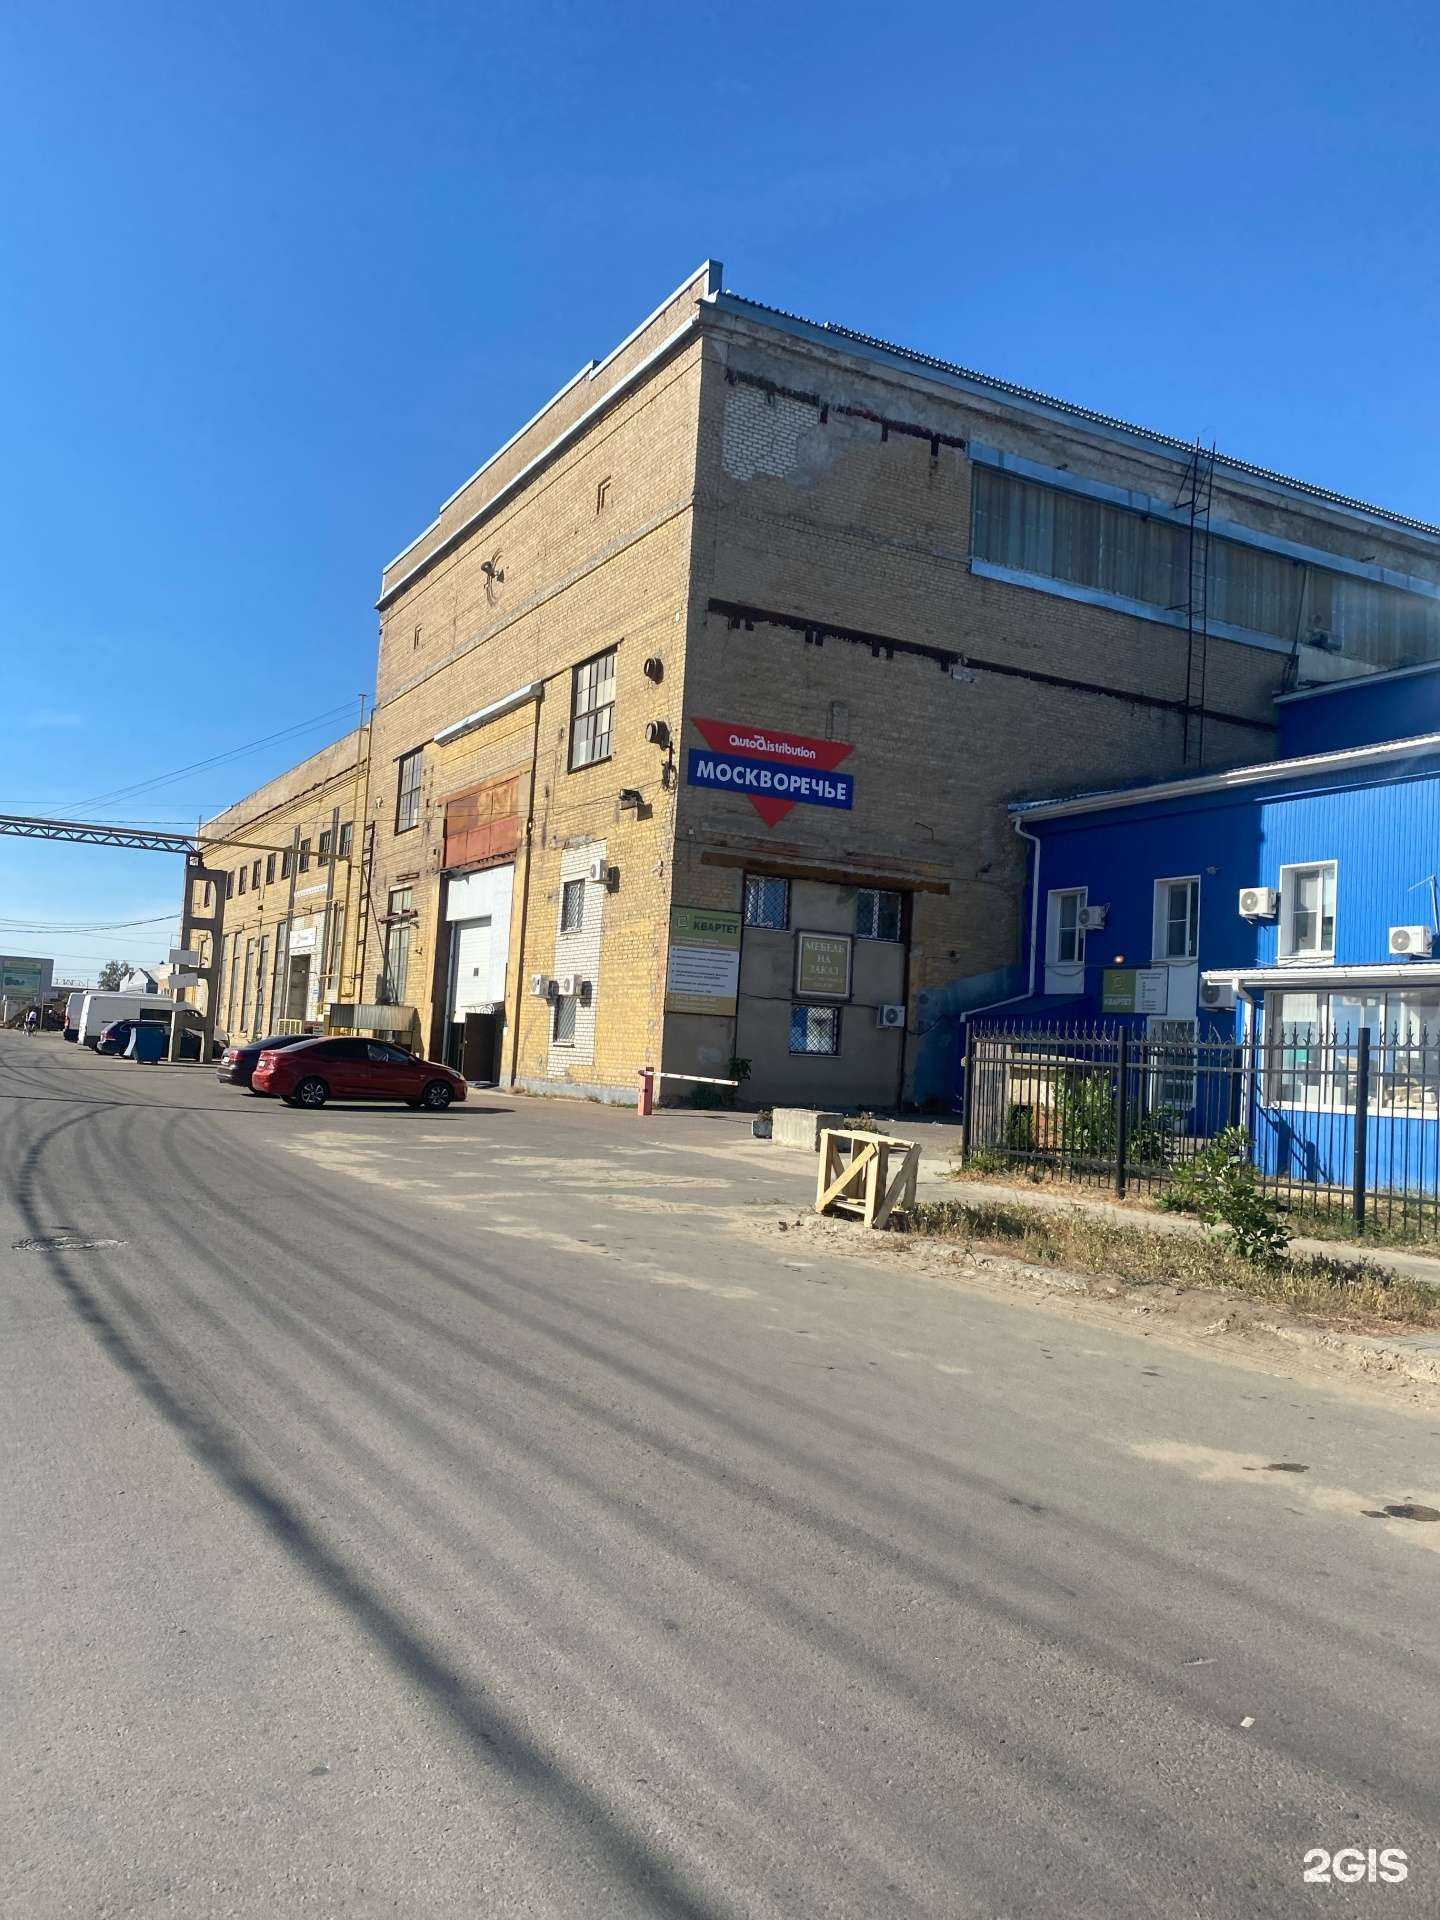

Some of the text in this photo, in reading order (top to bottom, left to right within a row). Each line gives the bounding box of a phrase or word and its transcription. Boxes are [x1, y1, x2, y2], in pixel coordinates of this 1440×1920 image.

[696, 760, 847, 800] МОСКВОРЕЧЬЕ
[693, 920, 739, 935] КВАРТЕТ
[805, 941, 845, 953] МЕБЕЛЬ
[816, 954, 832, 963] НА
